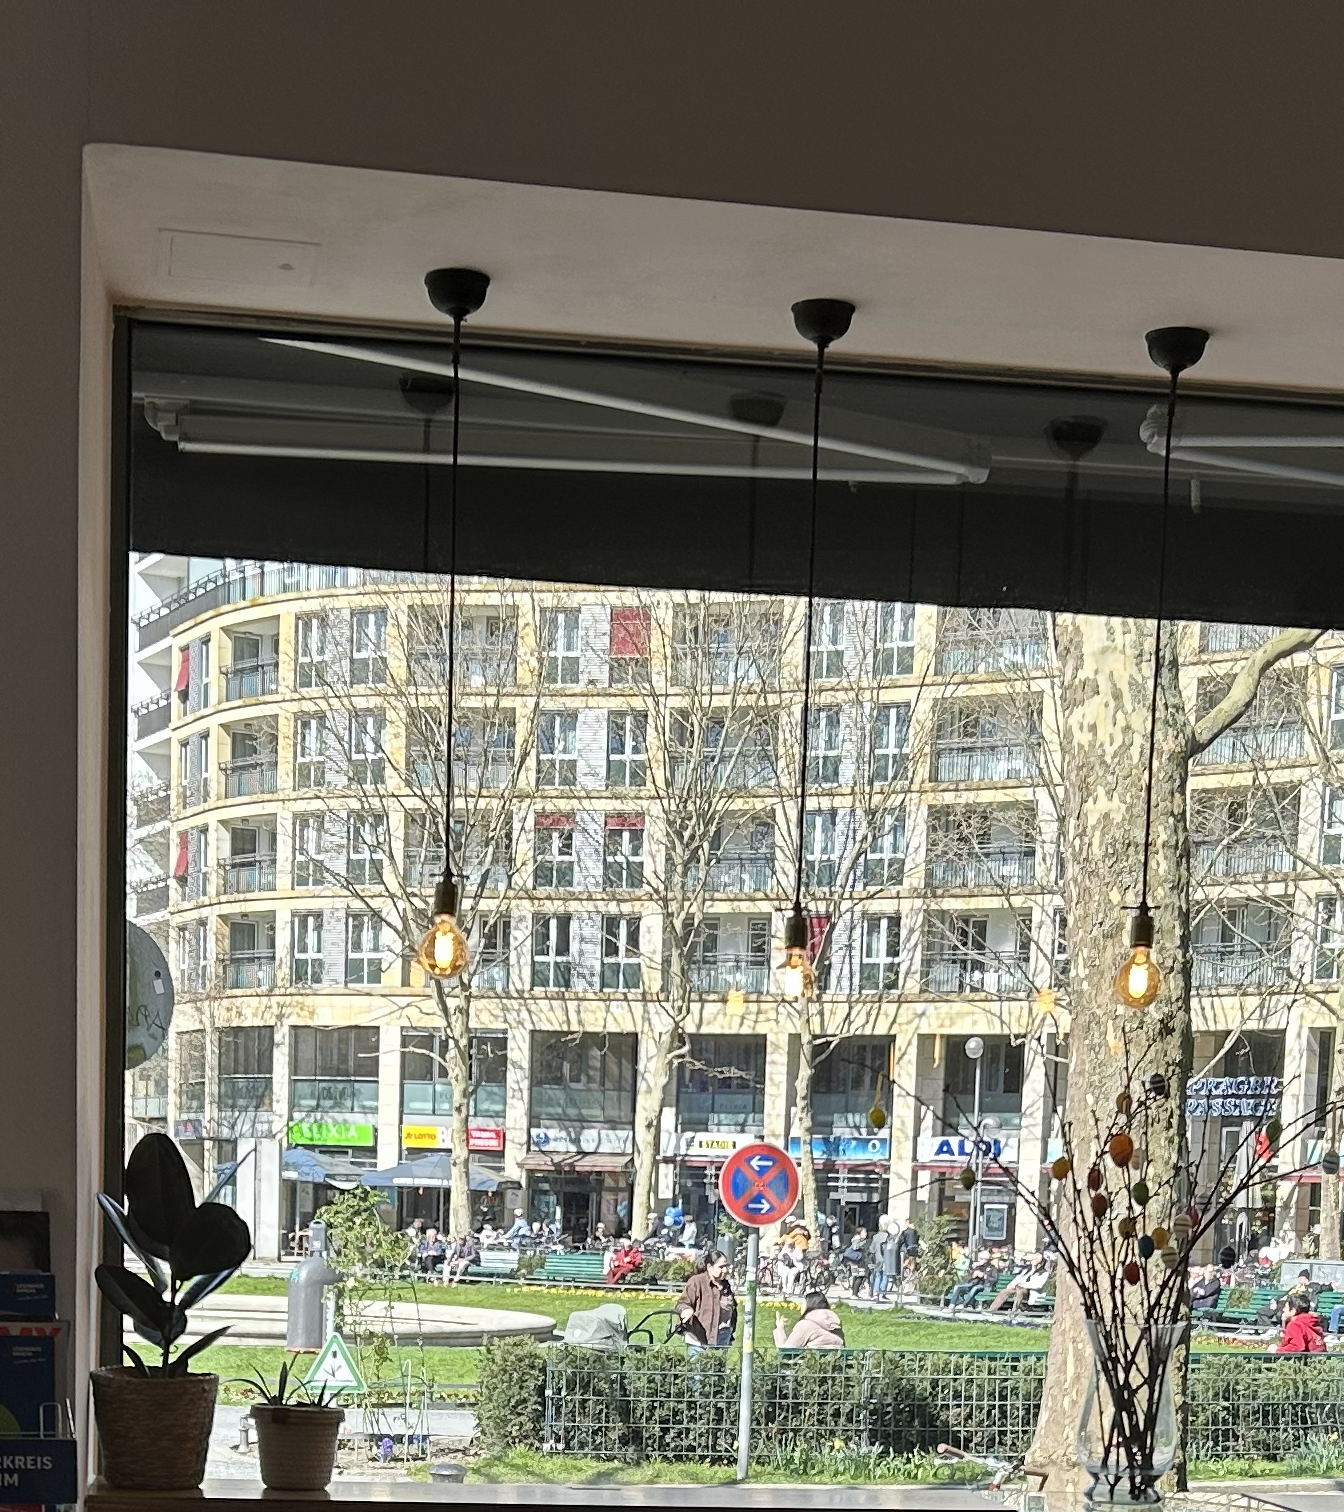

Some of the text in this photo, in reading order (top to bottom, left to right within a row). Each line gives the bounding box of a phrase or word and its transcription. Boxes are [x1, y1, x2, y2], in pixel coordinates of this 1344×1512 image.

[1185, 1076, 1278, 1096] PRAGER
[301, 1123, 359, 1140] ELIXIA
[413, 1133, 436, 1141] LOTTO
[933, 1139, 1002, 1157] ALDI
